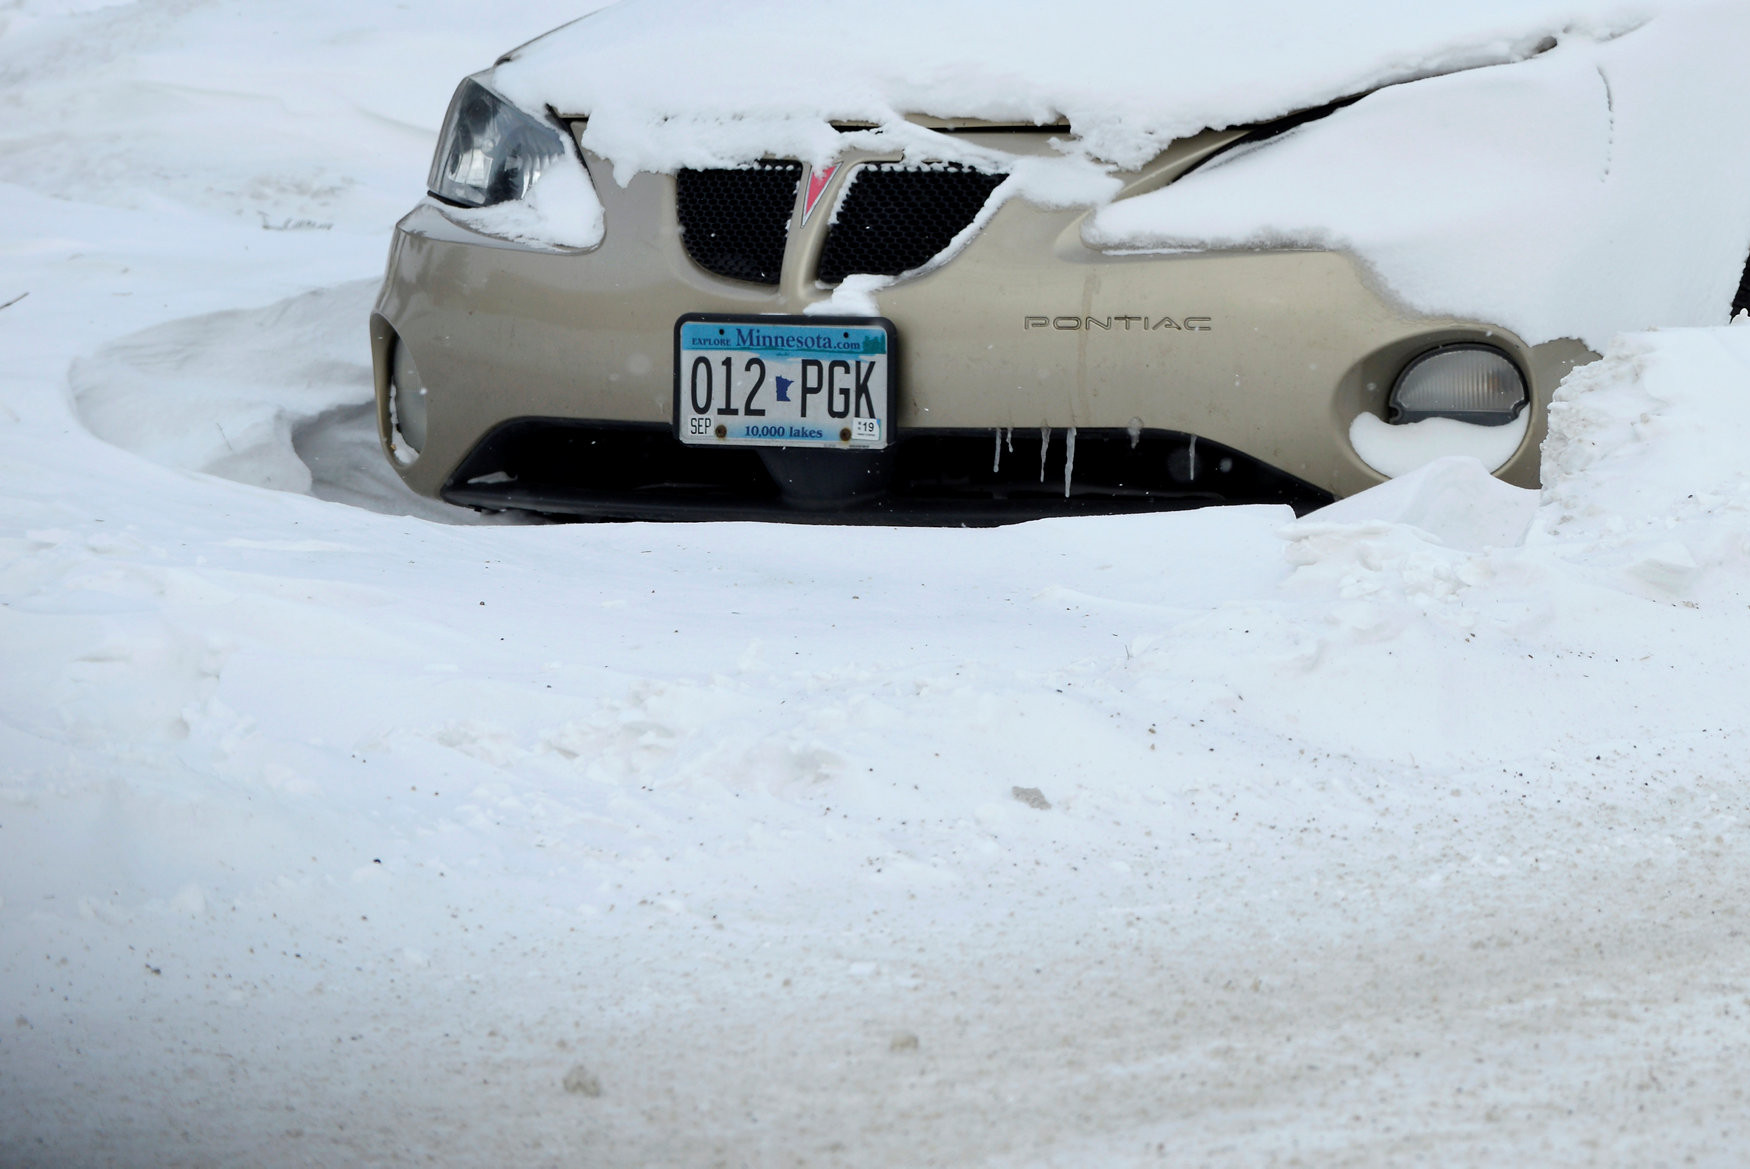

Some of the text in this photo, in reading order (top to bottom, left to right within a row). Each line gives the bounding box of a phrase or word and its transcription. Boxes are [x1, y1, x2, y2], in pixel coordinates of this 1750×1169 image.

[1024, 315, 1212, 331] PONTIAC
[691, 337, 732, 347] EXPLORE
[691, 355, 877, 420] 012 PGK
[690, 417, 712, 435] SEP
[745, 425, 823, 439] 10,000 lakes
[863, 421, 875, 433] 19
